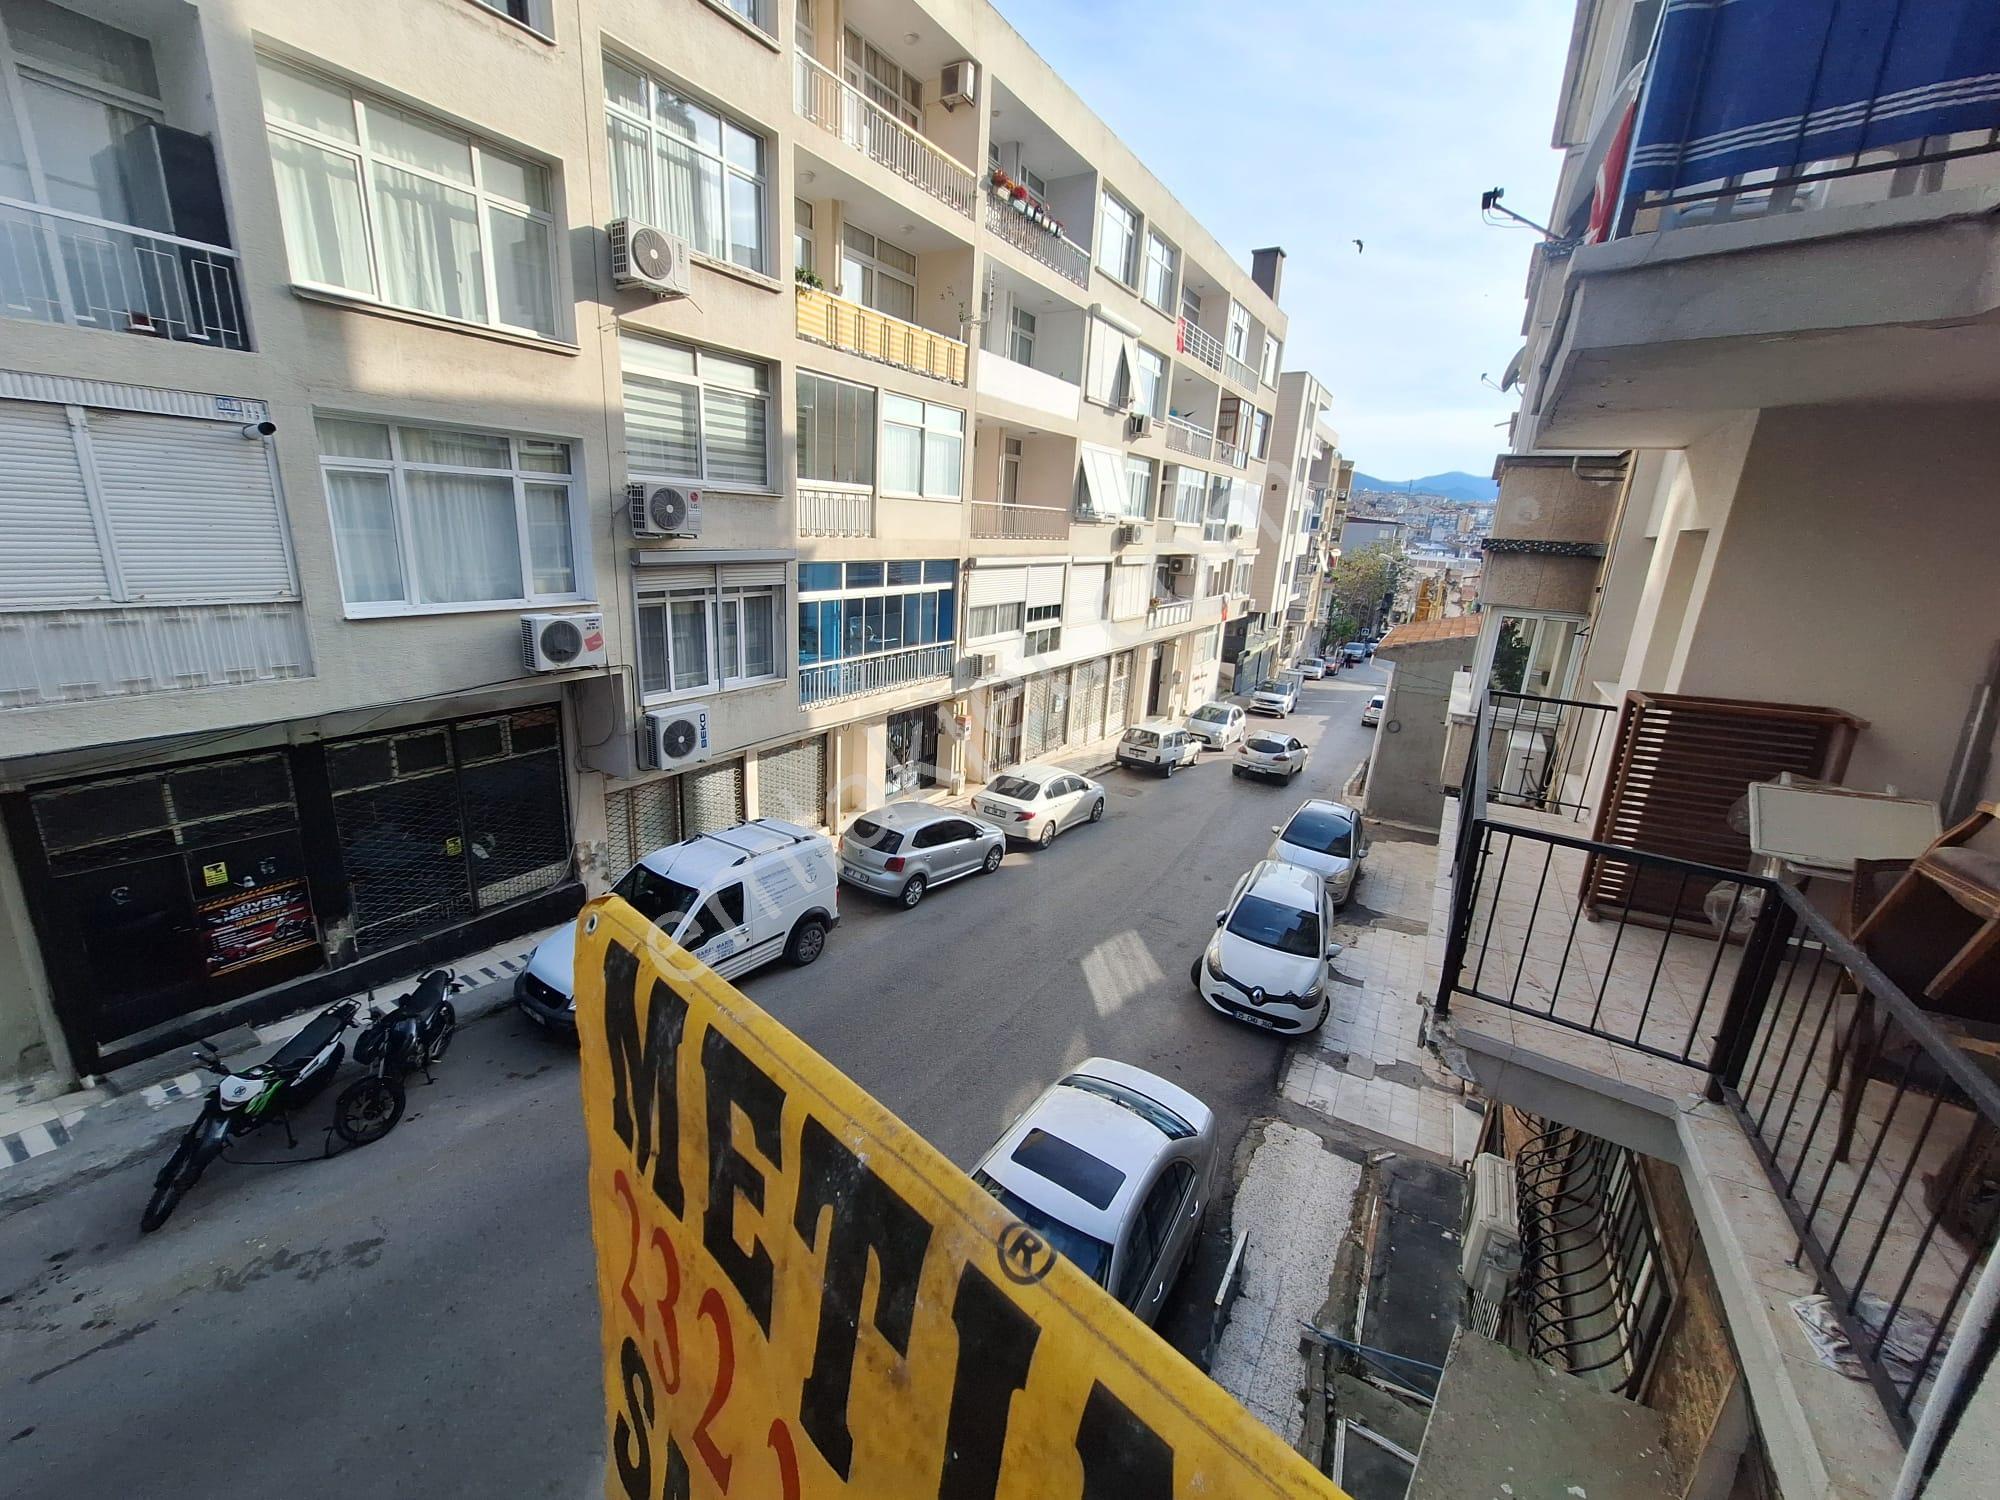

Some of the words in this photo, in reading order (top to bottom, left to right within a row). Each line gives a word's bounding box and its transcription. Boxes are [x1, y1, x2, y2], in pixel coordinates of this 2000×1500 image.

[699, 713, 708, 749] BEKO
[224, 908, 260, 922] MOTO
[262, 900, 288, 910] CAR
[230, 895, 282, 915] GÜVEN
